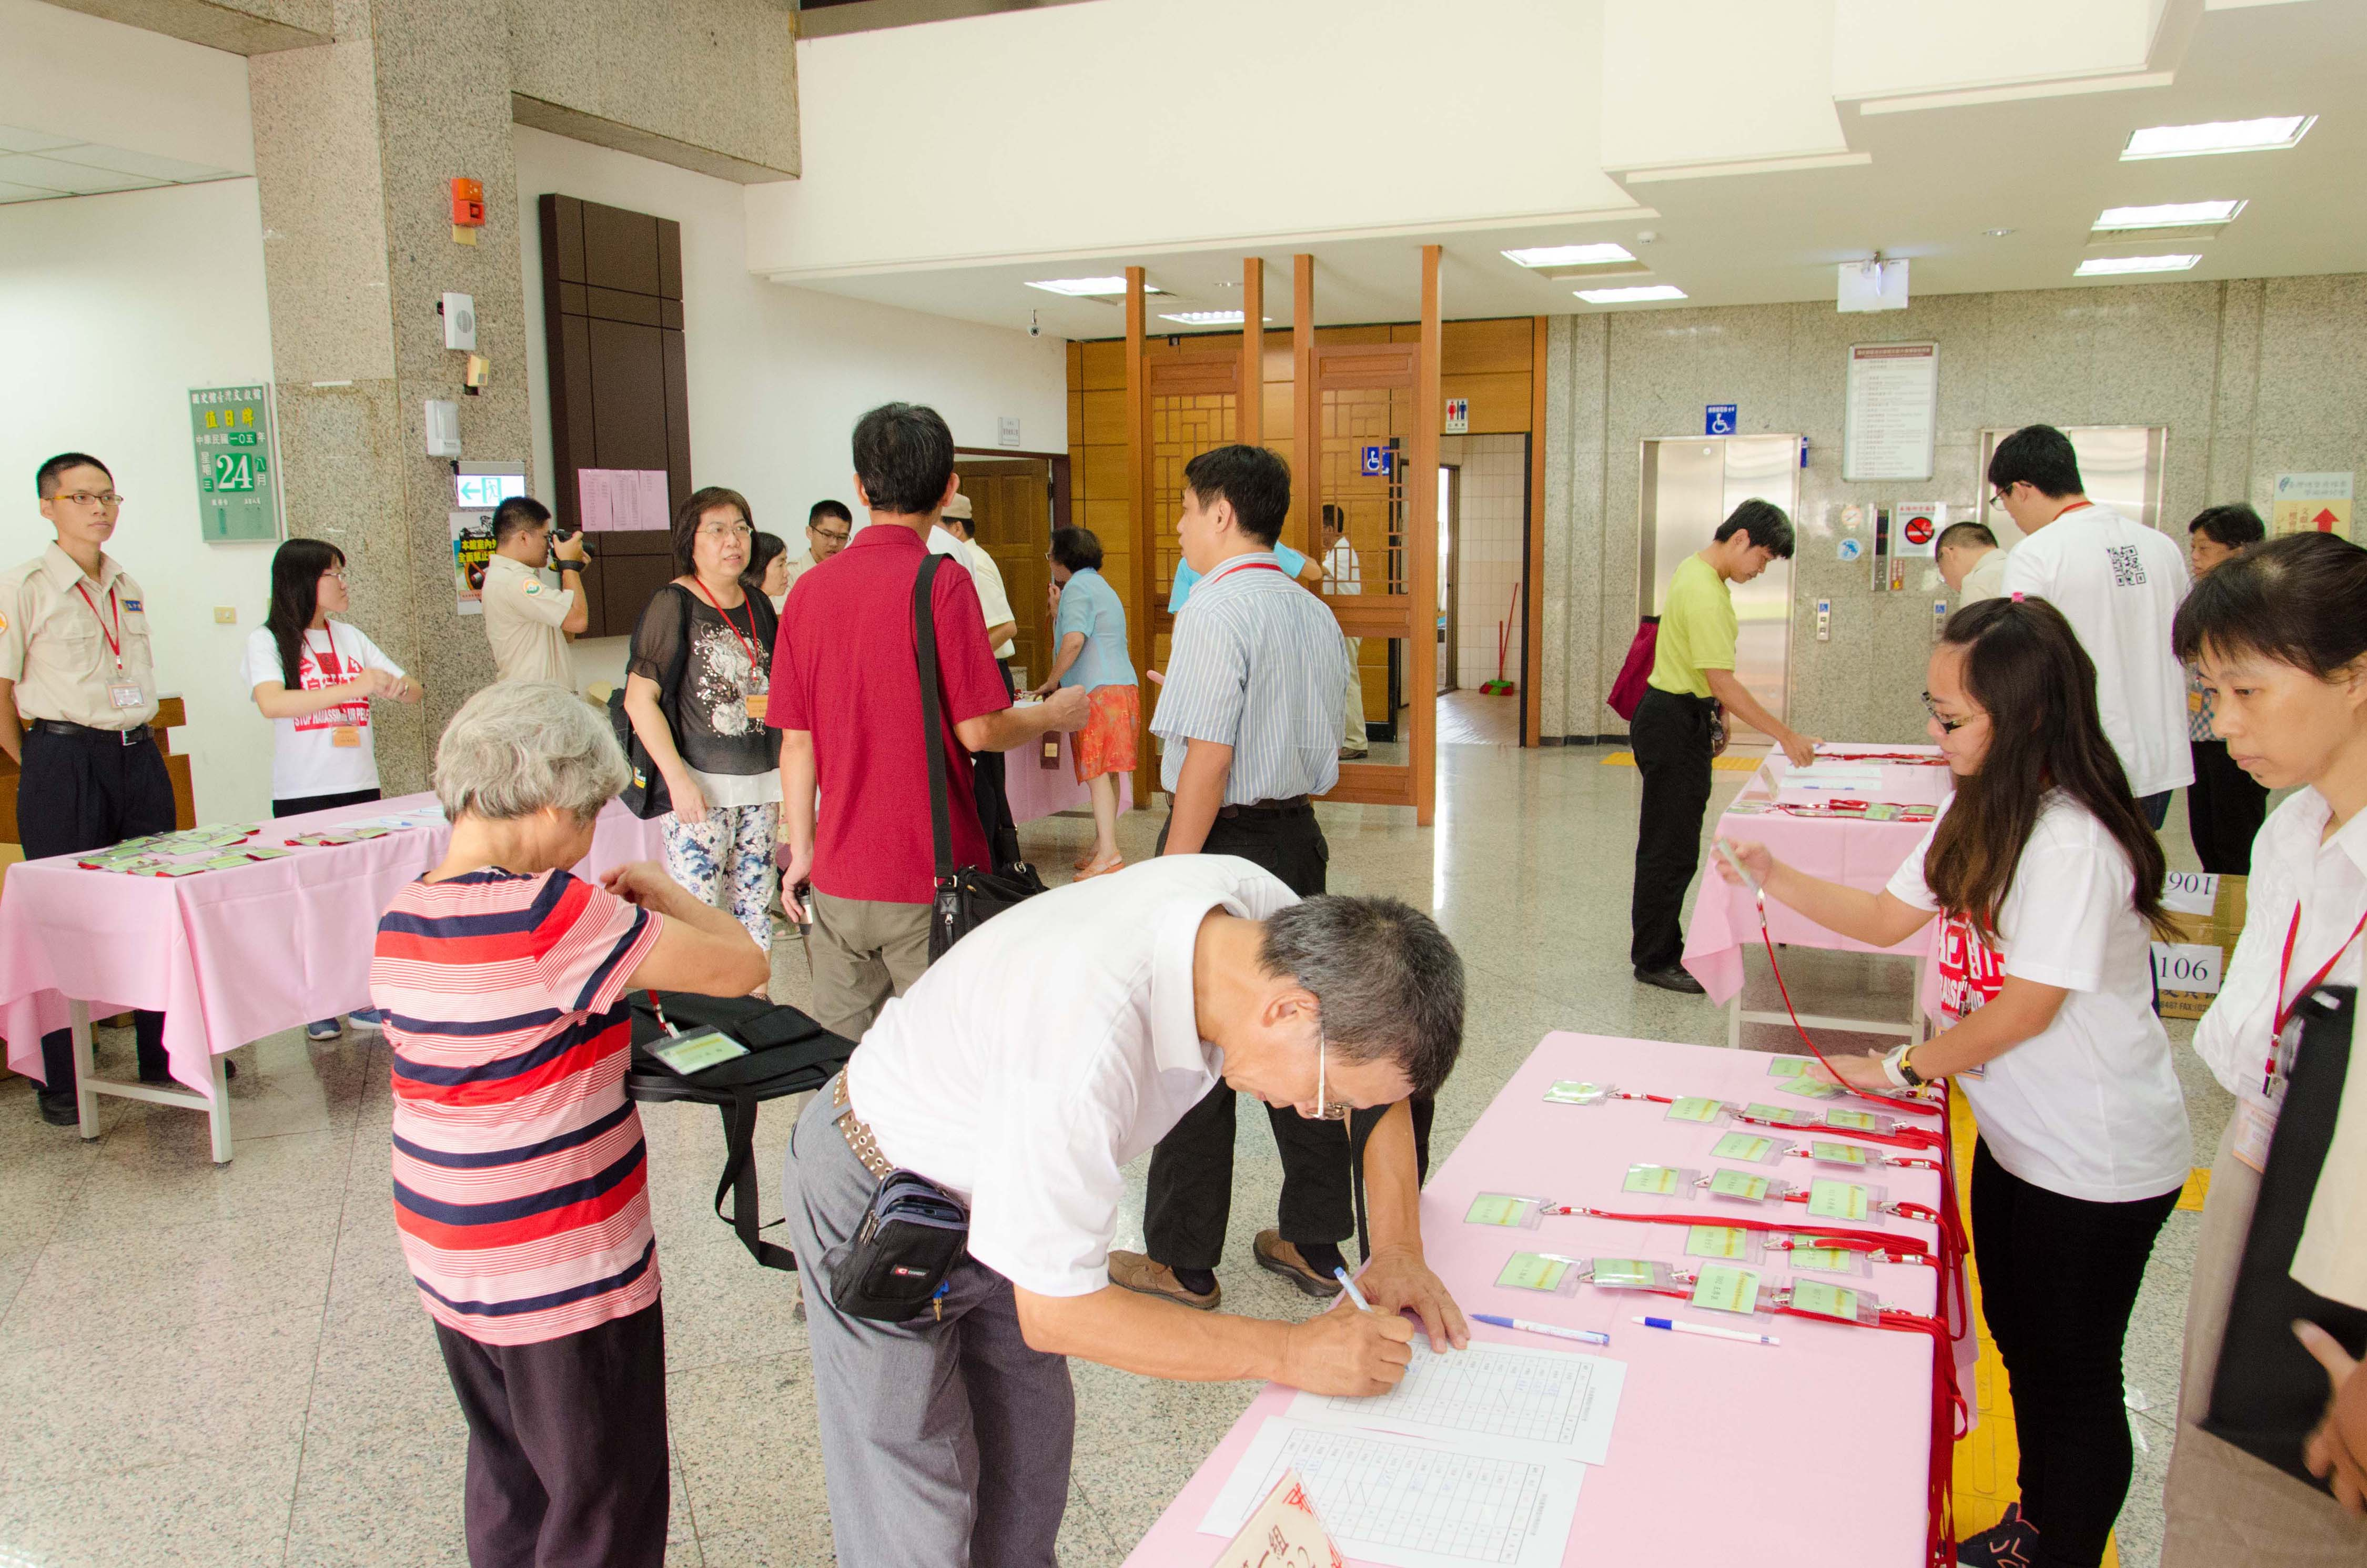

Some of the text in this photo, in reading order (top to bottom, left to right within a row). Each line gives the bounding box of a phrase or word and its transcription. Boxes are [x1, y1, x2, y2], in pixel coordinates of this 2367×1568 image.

[216, 454, 252, 489] 24
[458, 551, 495, 563] 全面禁止
[2160, 957, 2209, 981] 106
